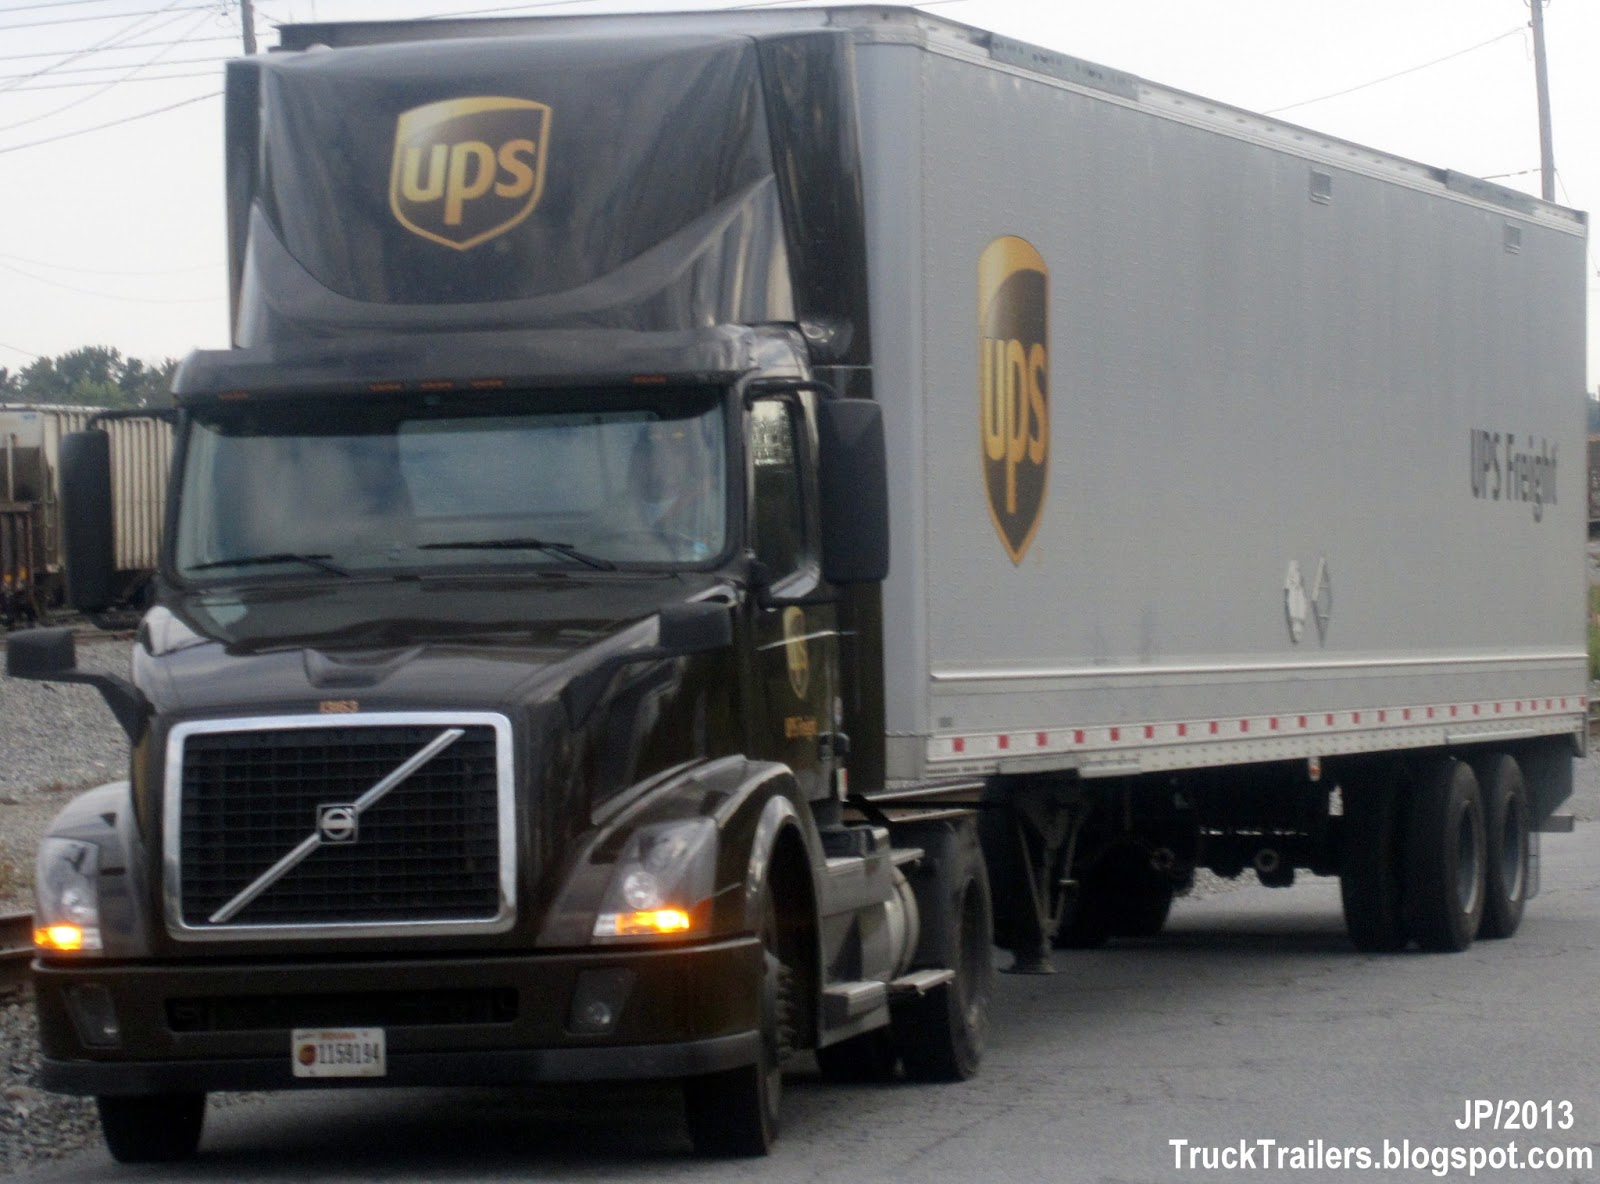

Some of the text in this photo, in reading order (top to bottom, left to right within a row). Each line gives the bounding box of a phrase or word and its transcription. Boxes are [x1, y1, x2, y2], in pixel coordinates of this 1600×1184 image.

[402, 138, 536, 226] ups
[984, 339, 1046, 513] ups
[1470, 429, 1558, 522] UPS Freight
